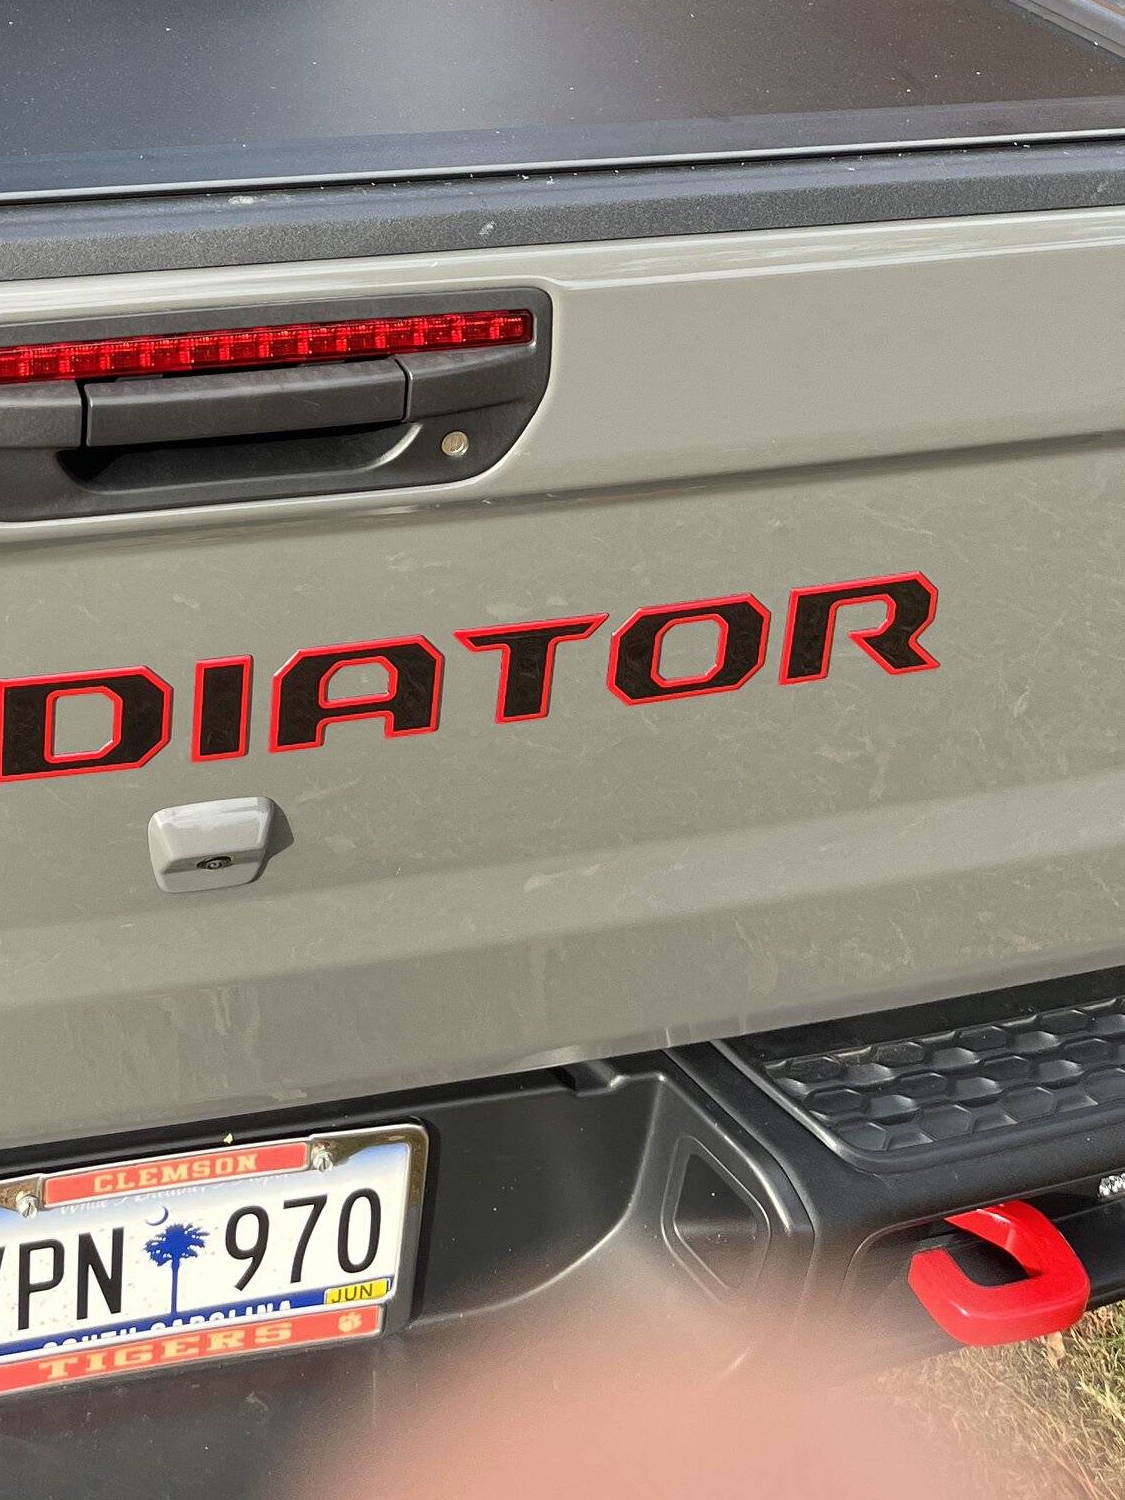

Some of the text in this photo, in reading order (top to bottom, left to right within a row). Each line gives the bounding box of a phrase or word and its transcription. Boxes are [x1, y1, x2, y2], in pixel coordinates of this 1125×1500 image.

[94, 1153, 258, 1193] CLEMSON
[224, 1187, 383, 1292] 970
[331, 1283, 373, 1303] JUN
[38, 1322, 293, 1380] TIGERS
